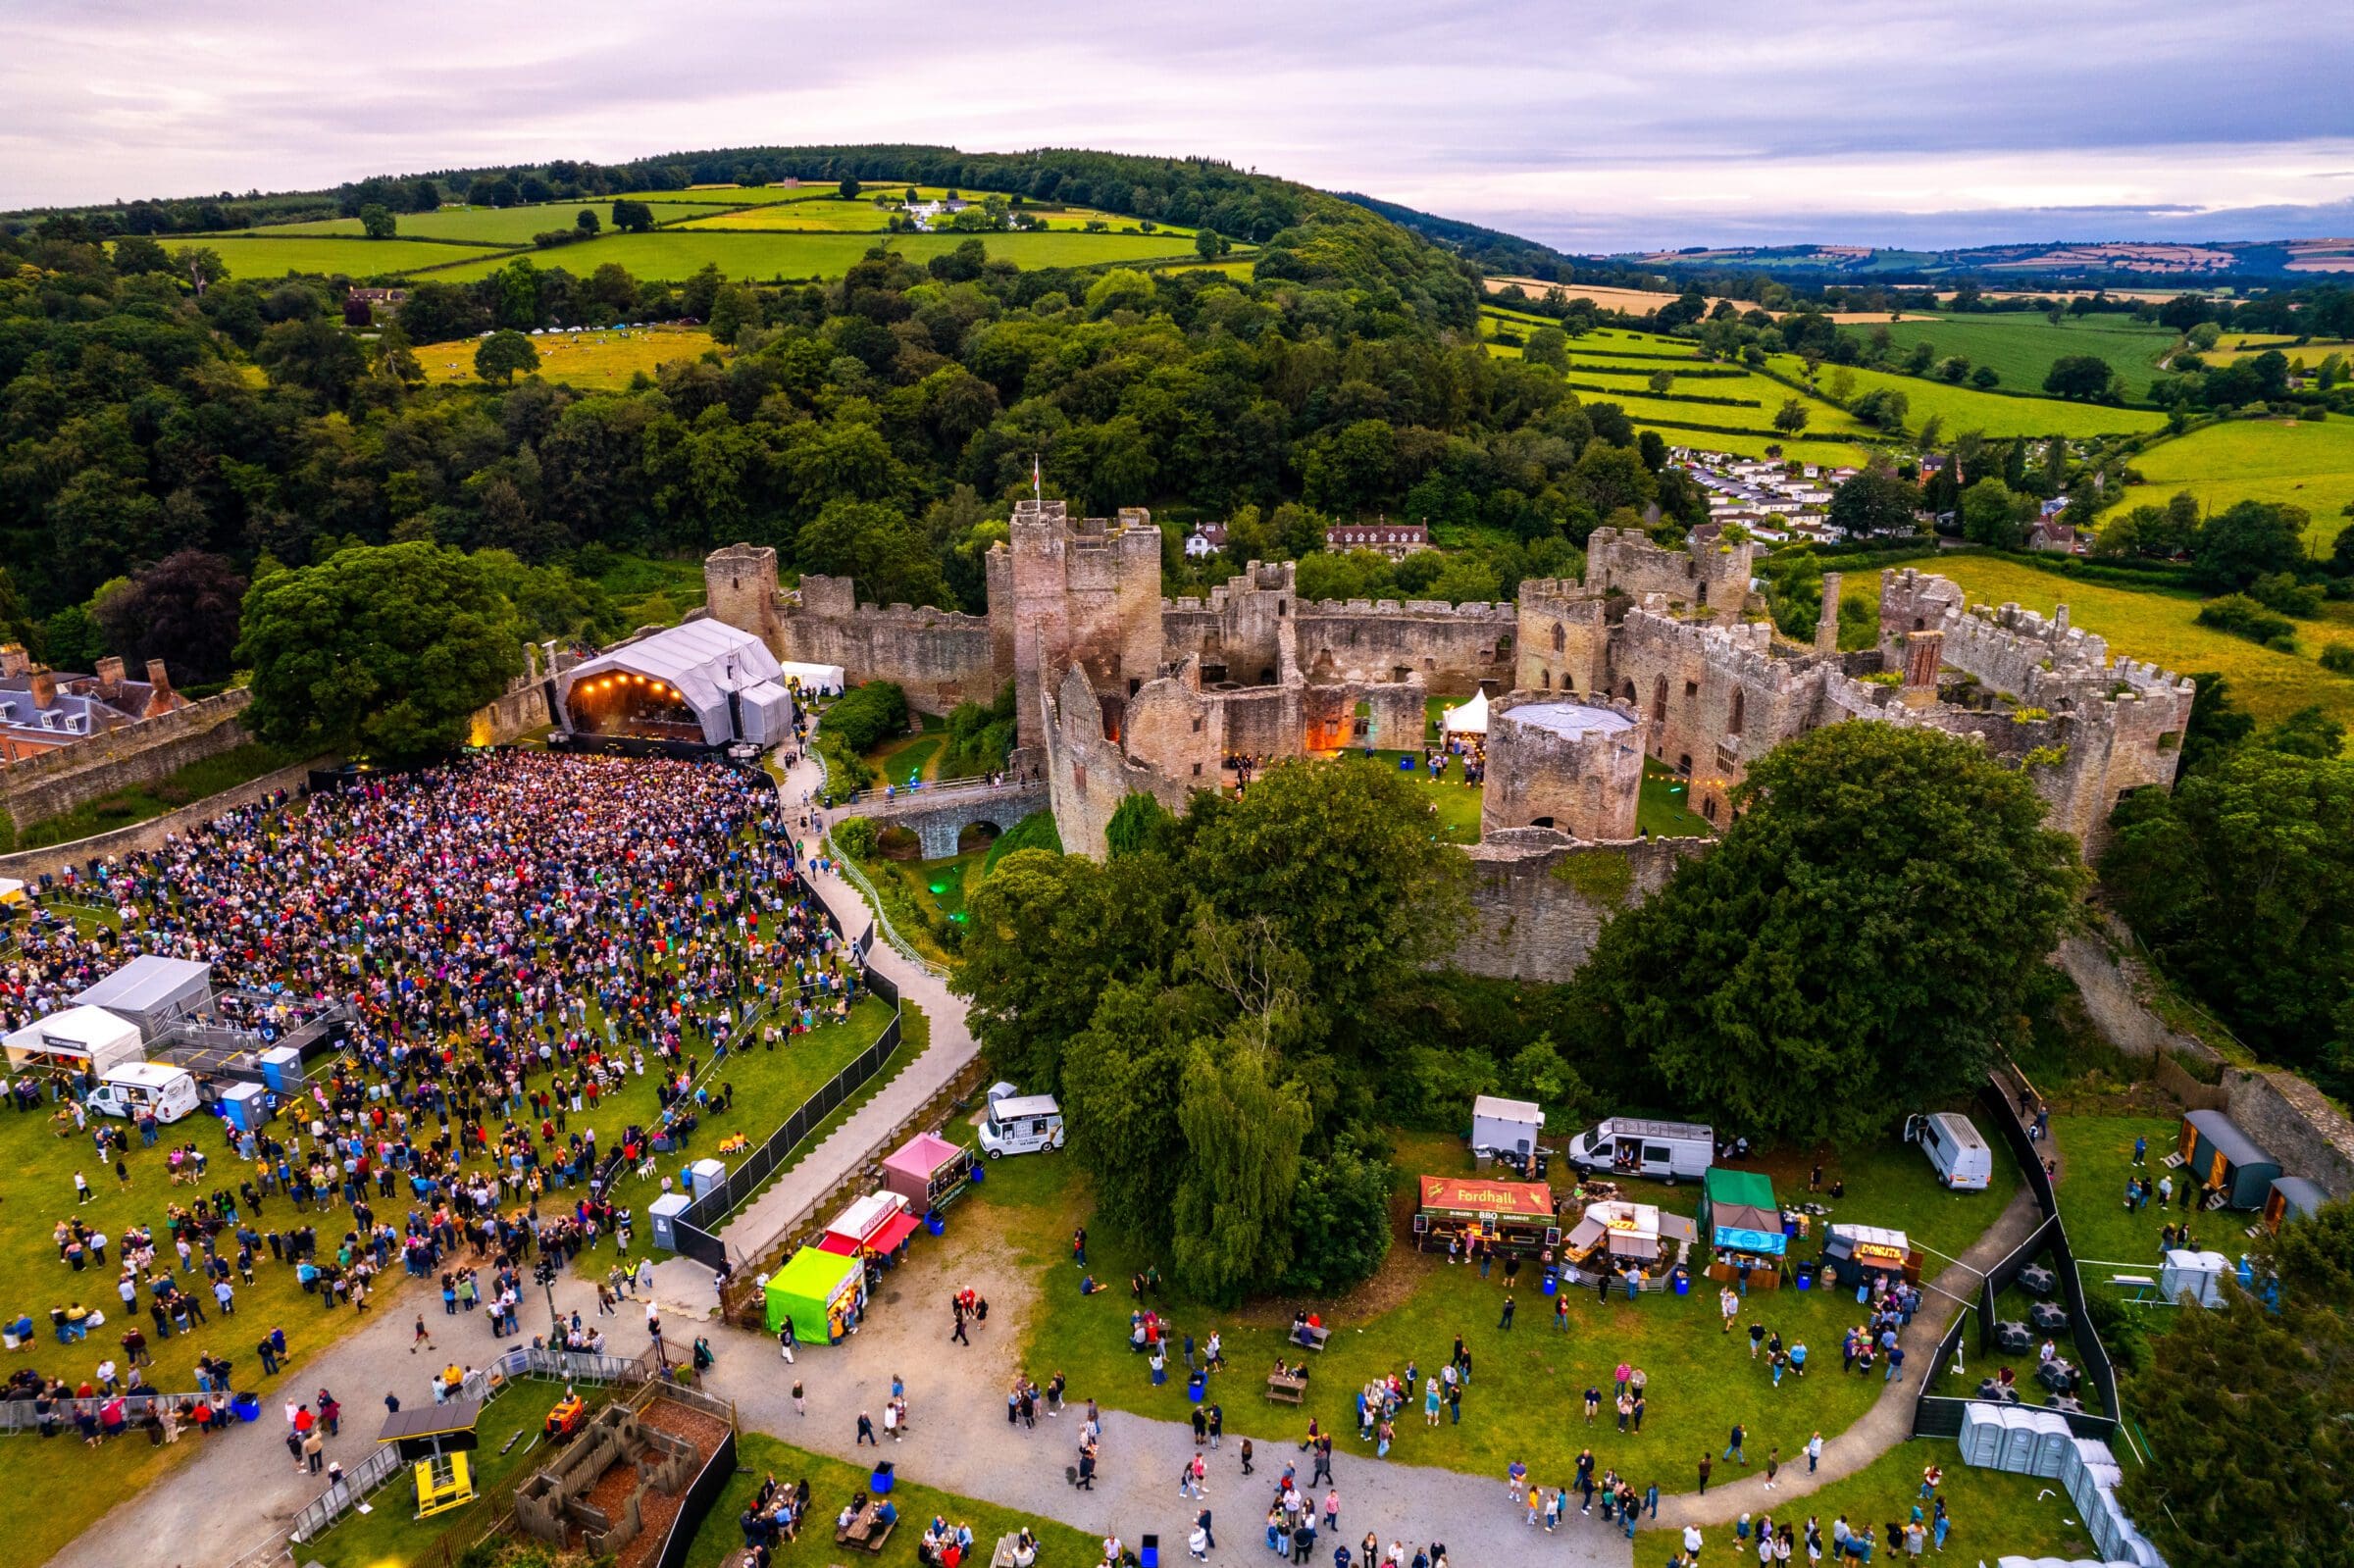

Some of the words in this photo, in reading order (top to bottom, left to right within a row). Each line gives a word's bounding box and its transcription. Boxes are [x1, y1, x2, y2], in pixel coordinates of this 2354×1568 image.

[1458, 1189, 1512, 1204] Fordhall
[1479, 1211, 1498, 1220] BBQ
[1607, 1219, 1639, 1231] PIZZA
[1862, 1244, 1901, 1258] DONUTS
